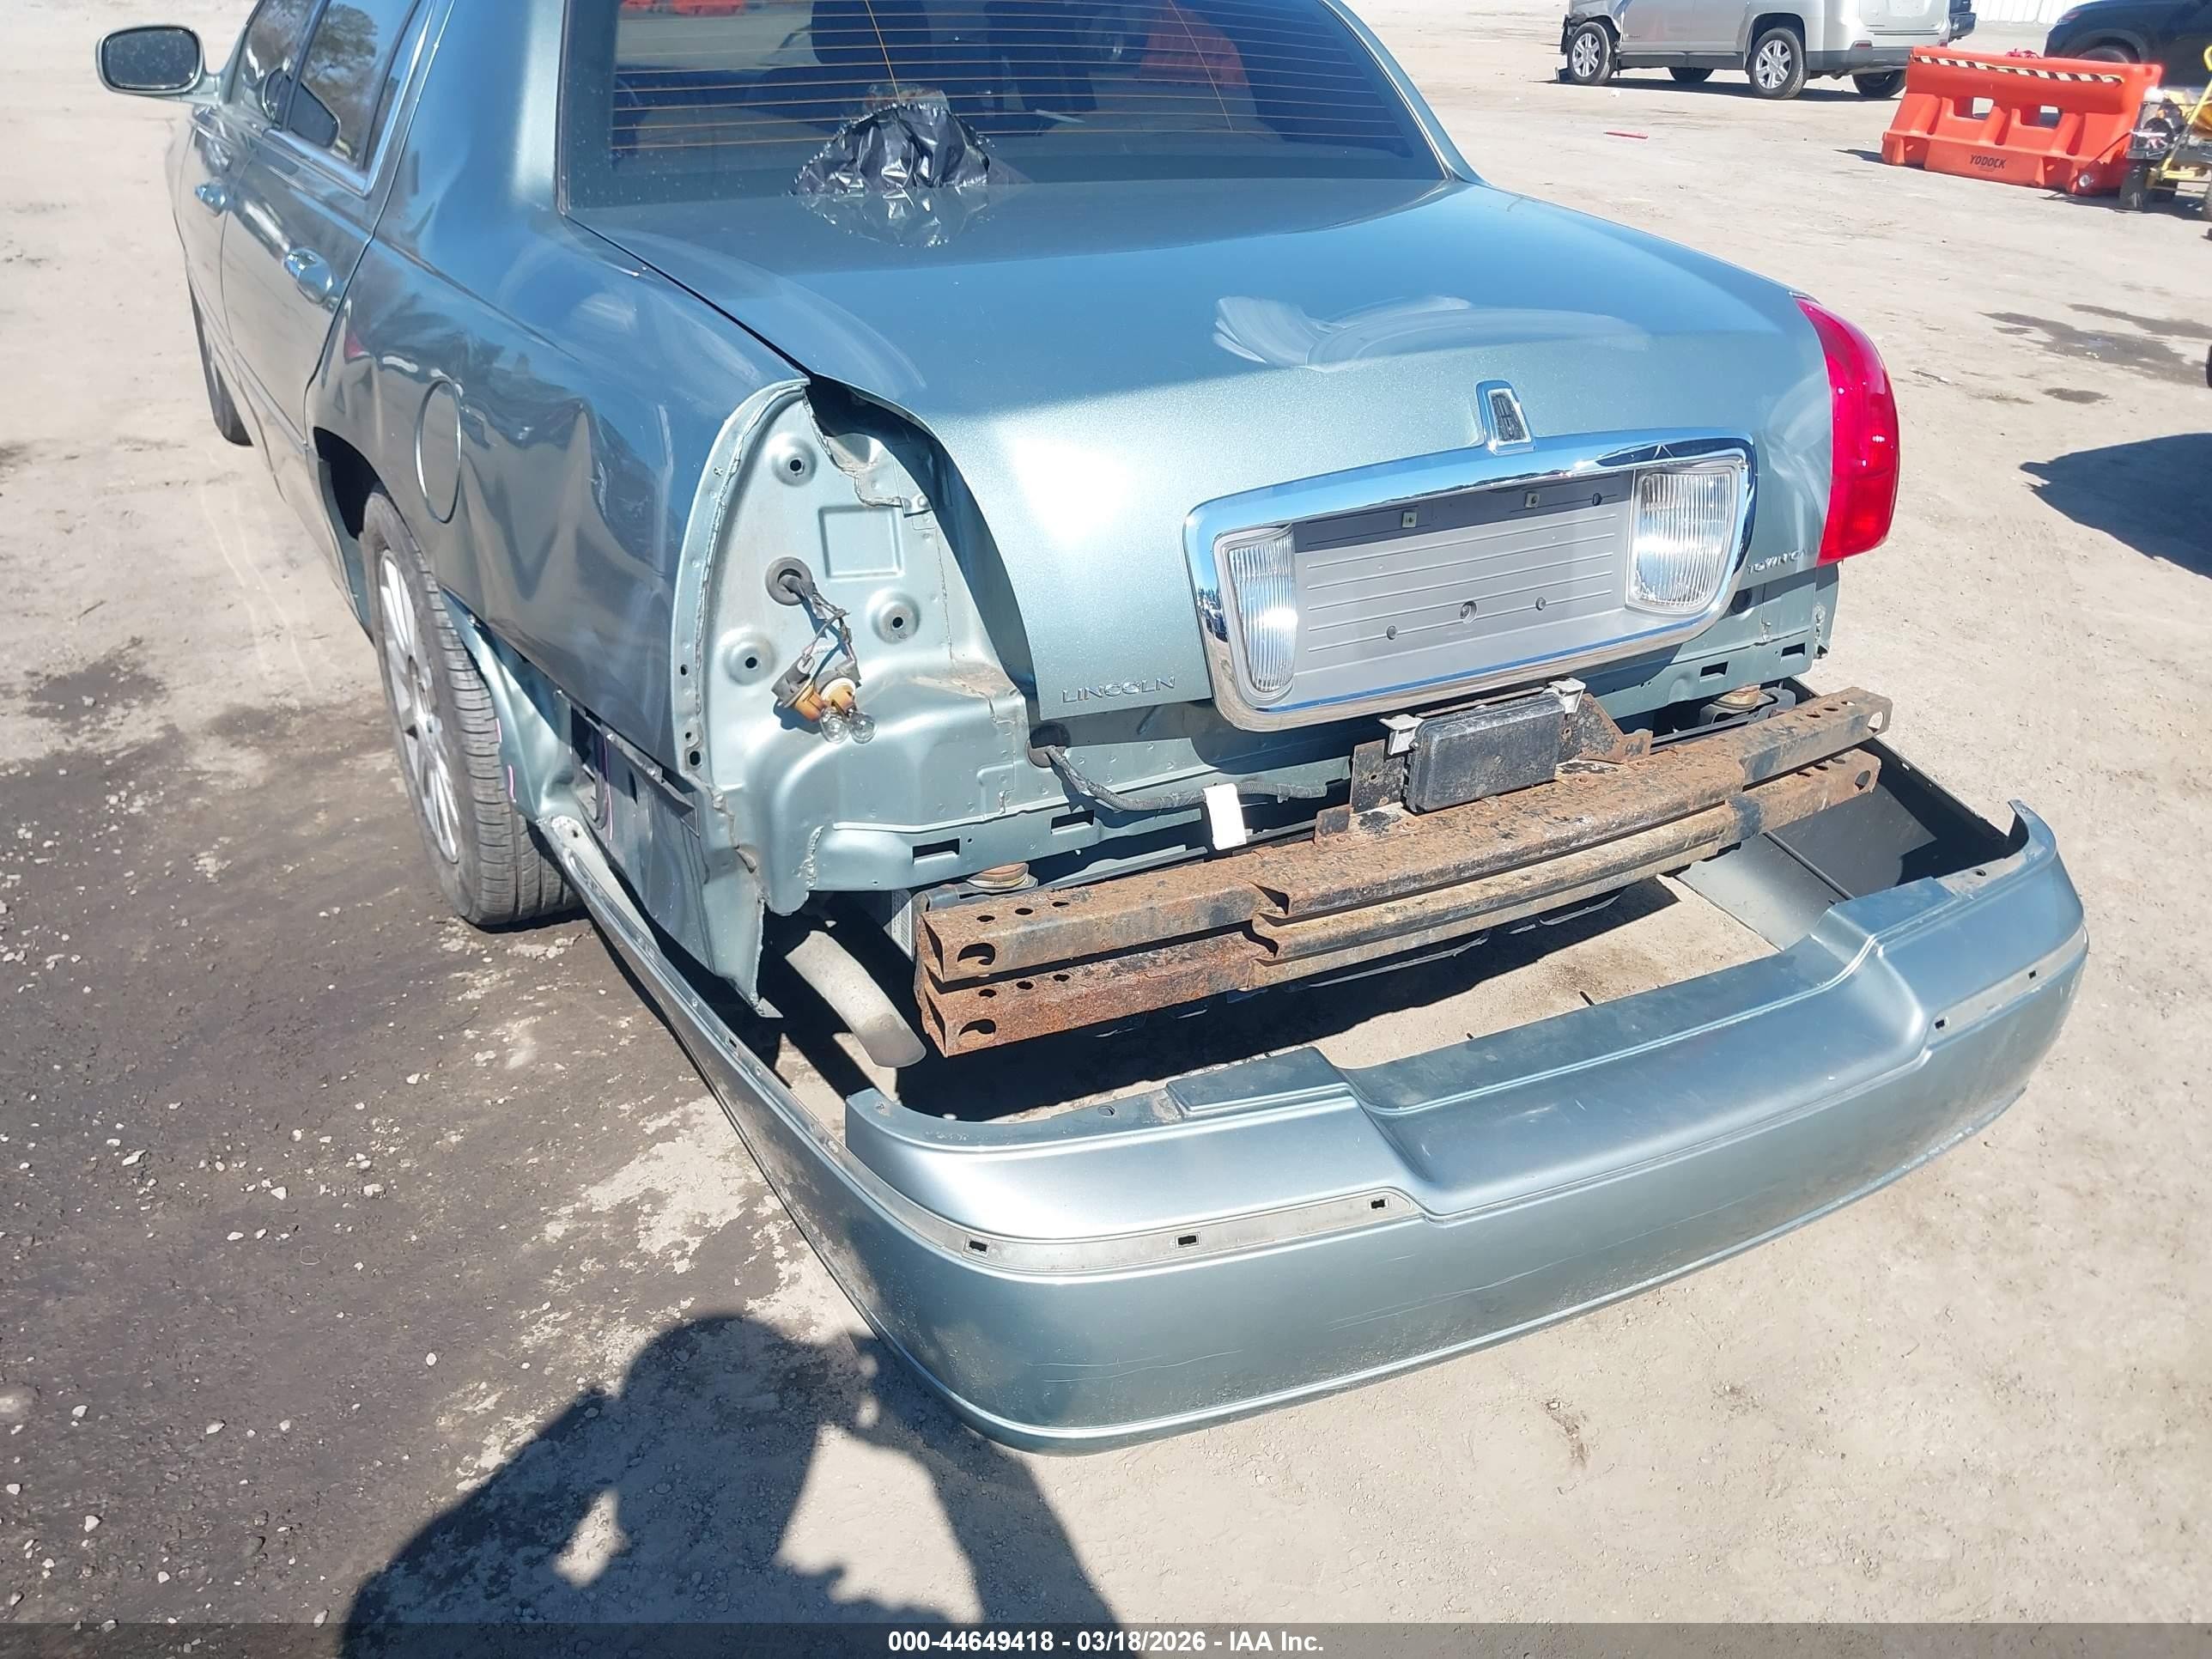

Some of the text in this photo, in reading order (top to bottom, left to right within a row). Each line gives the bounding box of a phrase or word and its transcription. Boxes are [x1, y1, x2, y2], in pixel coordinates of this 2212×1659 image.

[1969, 154, 2007, 169] YODOCK
[1747, 552, 1789, 574] TOWN
[1061, 676, 1176, 703] LINCOLN
